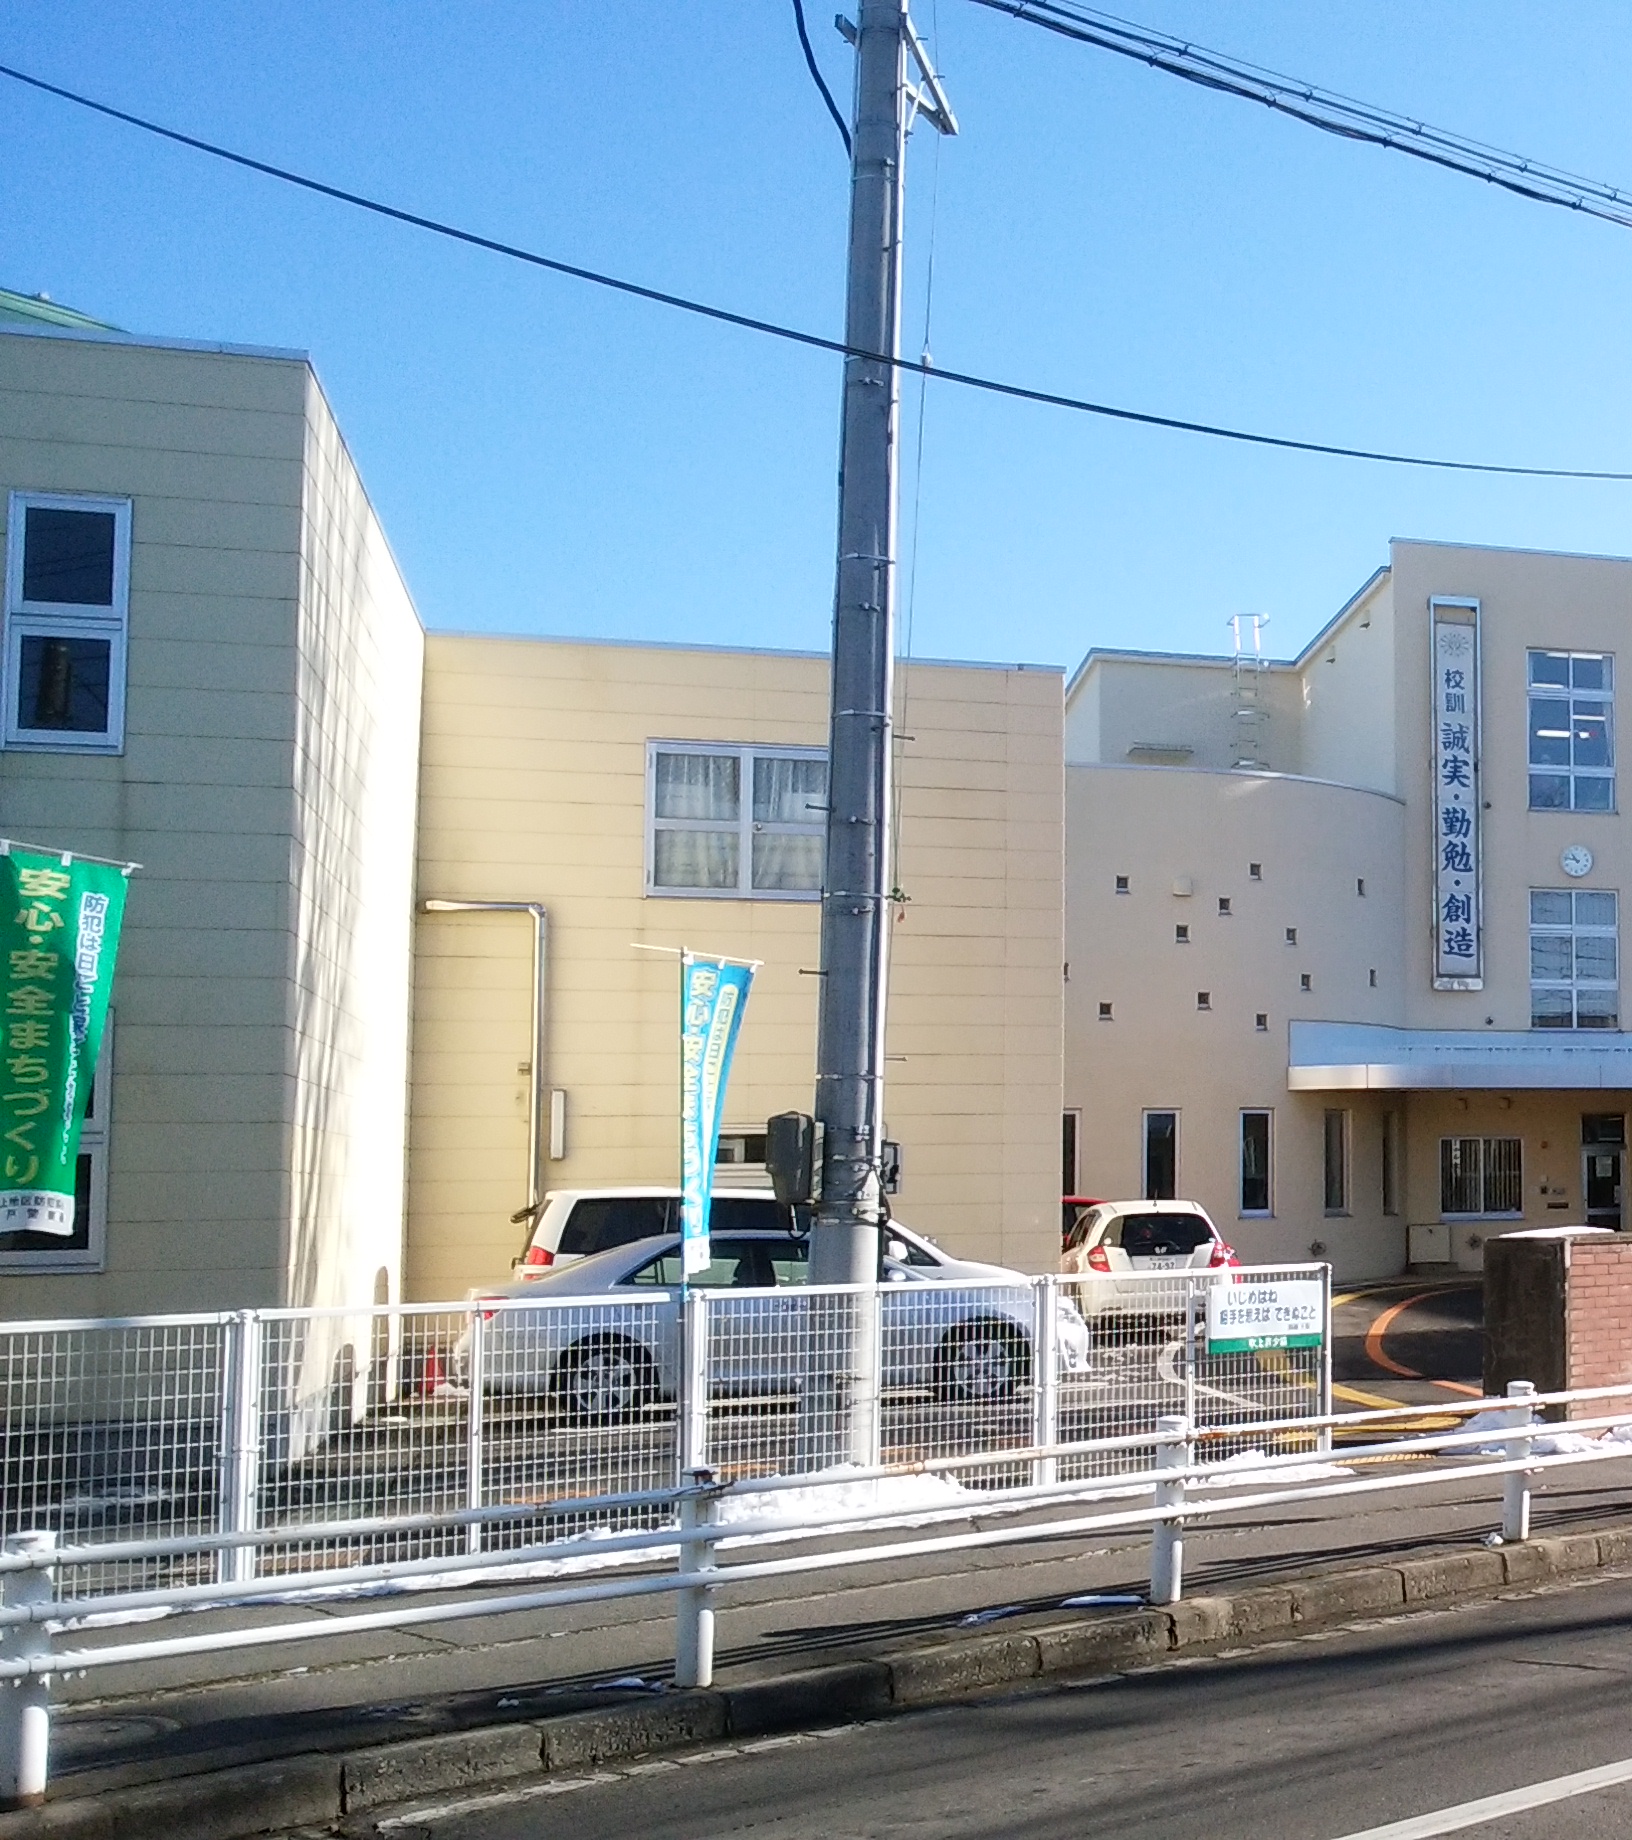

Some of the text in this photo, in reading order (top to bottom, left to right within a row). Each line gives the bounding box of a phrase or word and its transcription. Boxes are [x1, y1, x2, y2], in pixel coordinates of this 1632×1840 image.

[1445, 668, 1466, 713] 校訓
[1441, 722, 1475, 958] 誠実・勤勉・創造
[5, 867, 71, 1185] 安心・安全まちづくり
